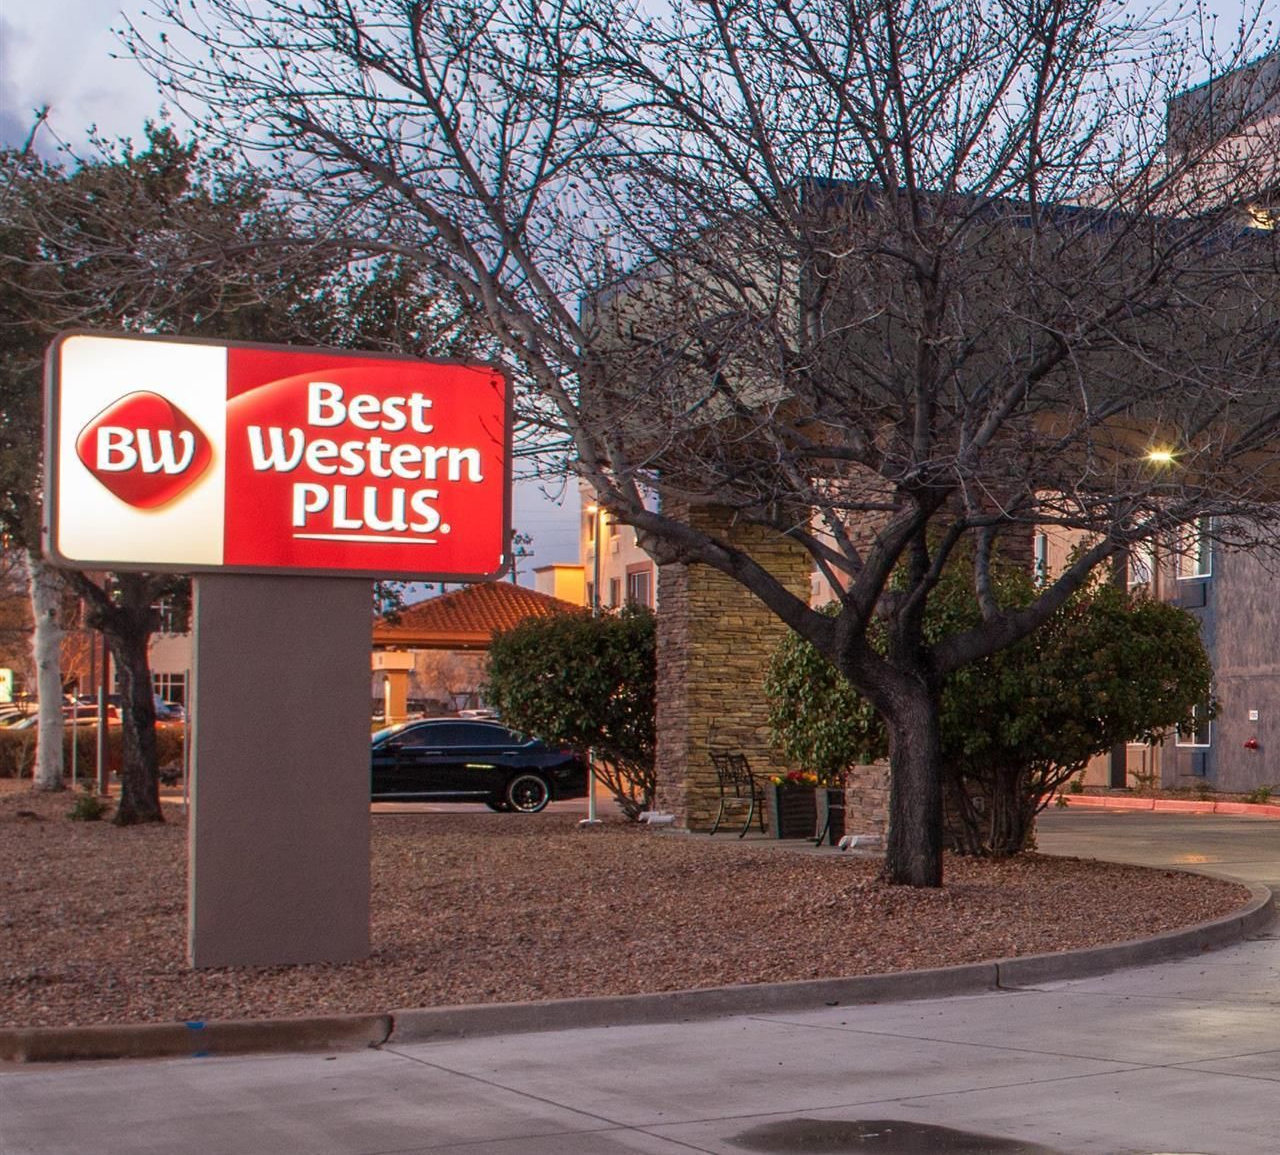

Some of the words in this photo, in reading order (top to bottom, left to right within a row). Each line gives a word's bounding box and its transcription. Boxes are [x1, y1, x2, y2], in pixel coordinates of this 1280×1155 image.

[307, 381, 434, 433] Best
[96, 426, 196, 475] BW
[247, 425, 484, 483] Western
